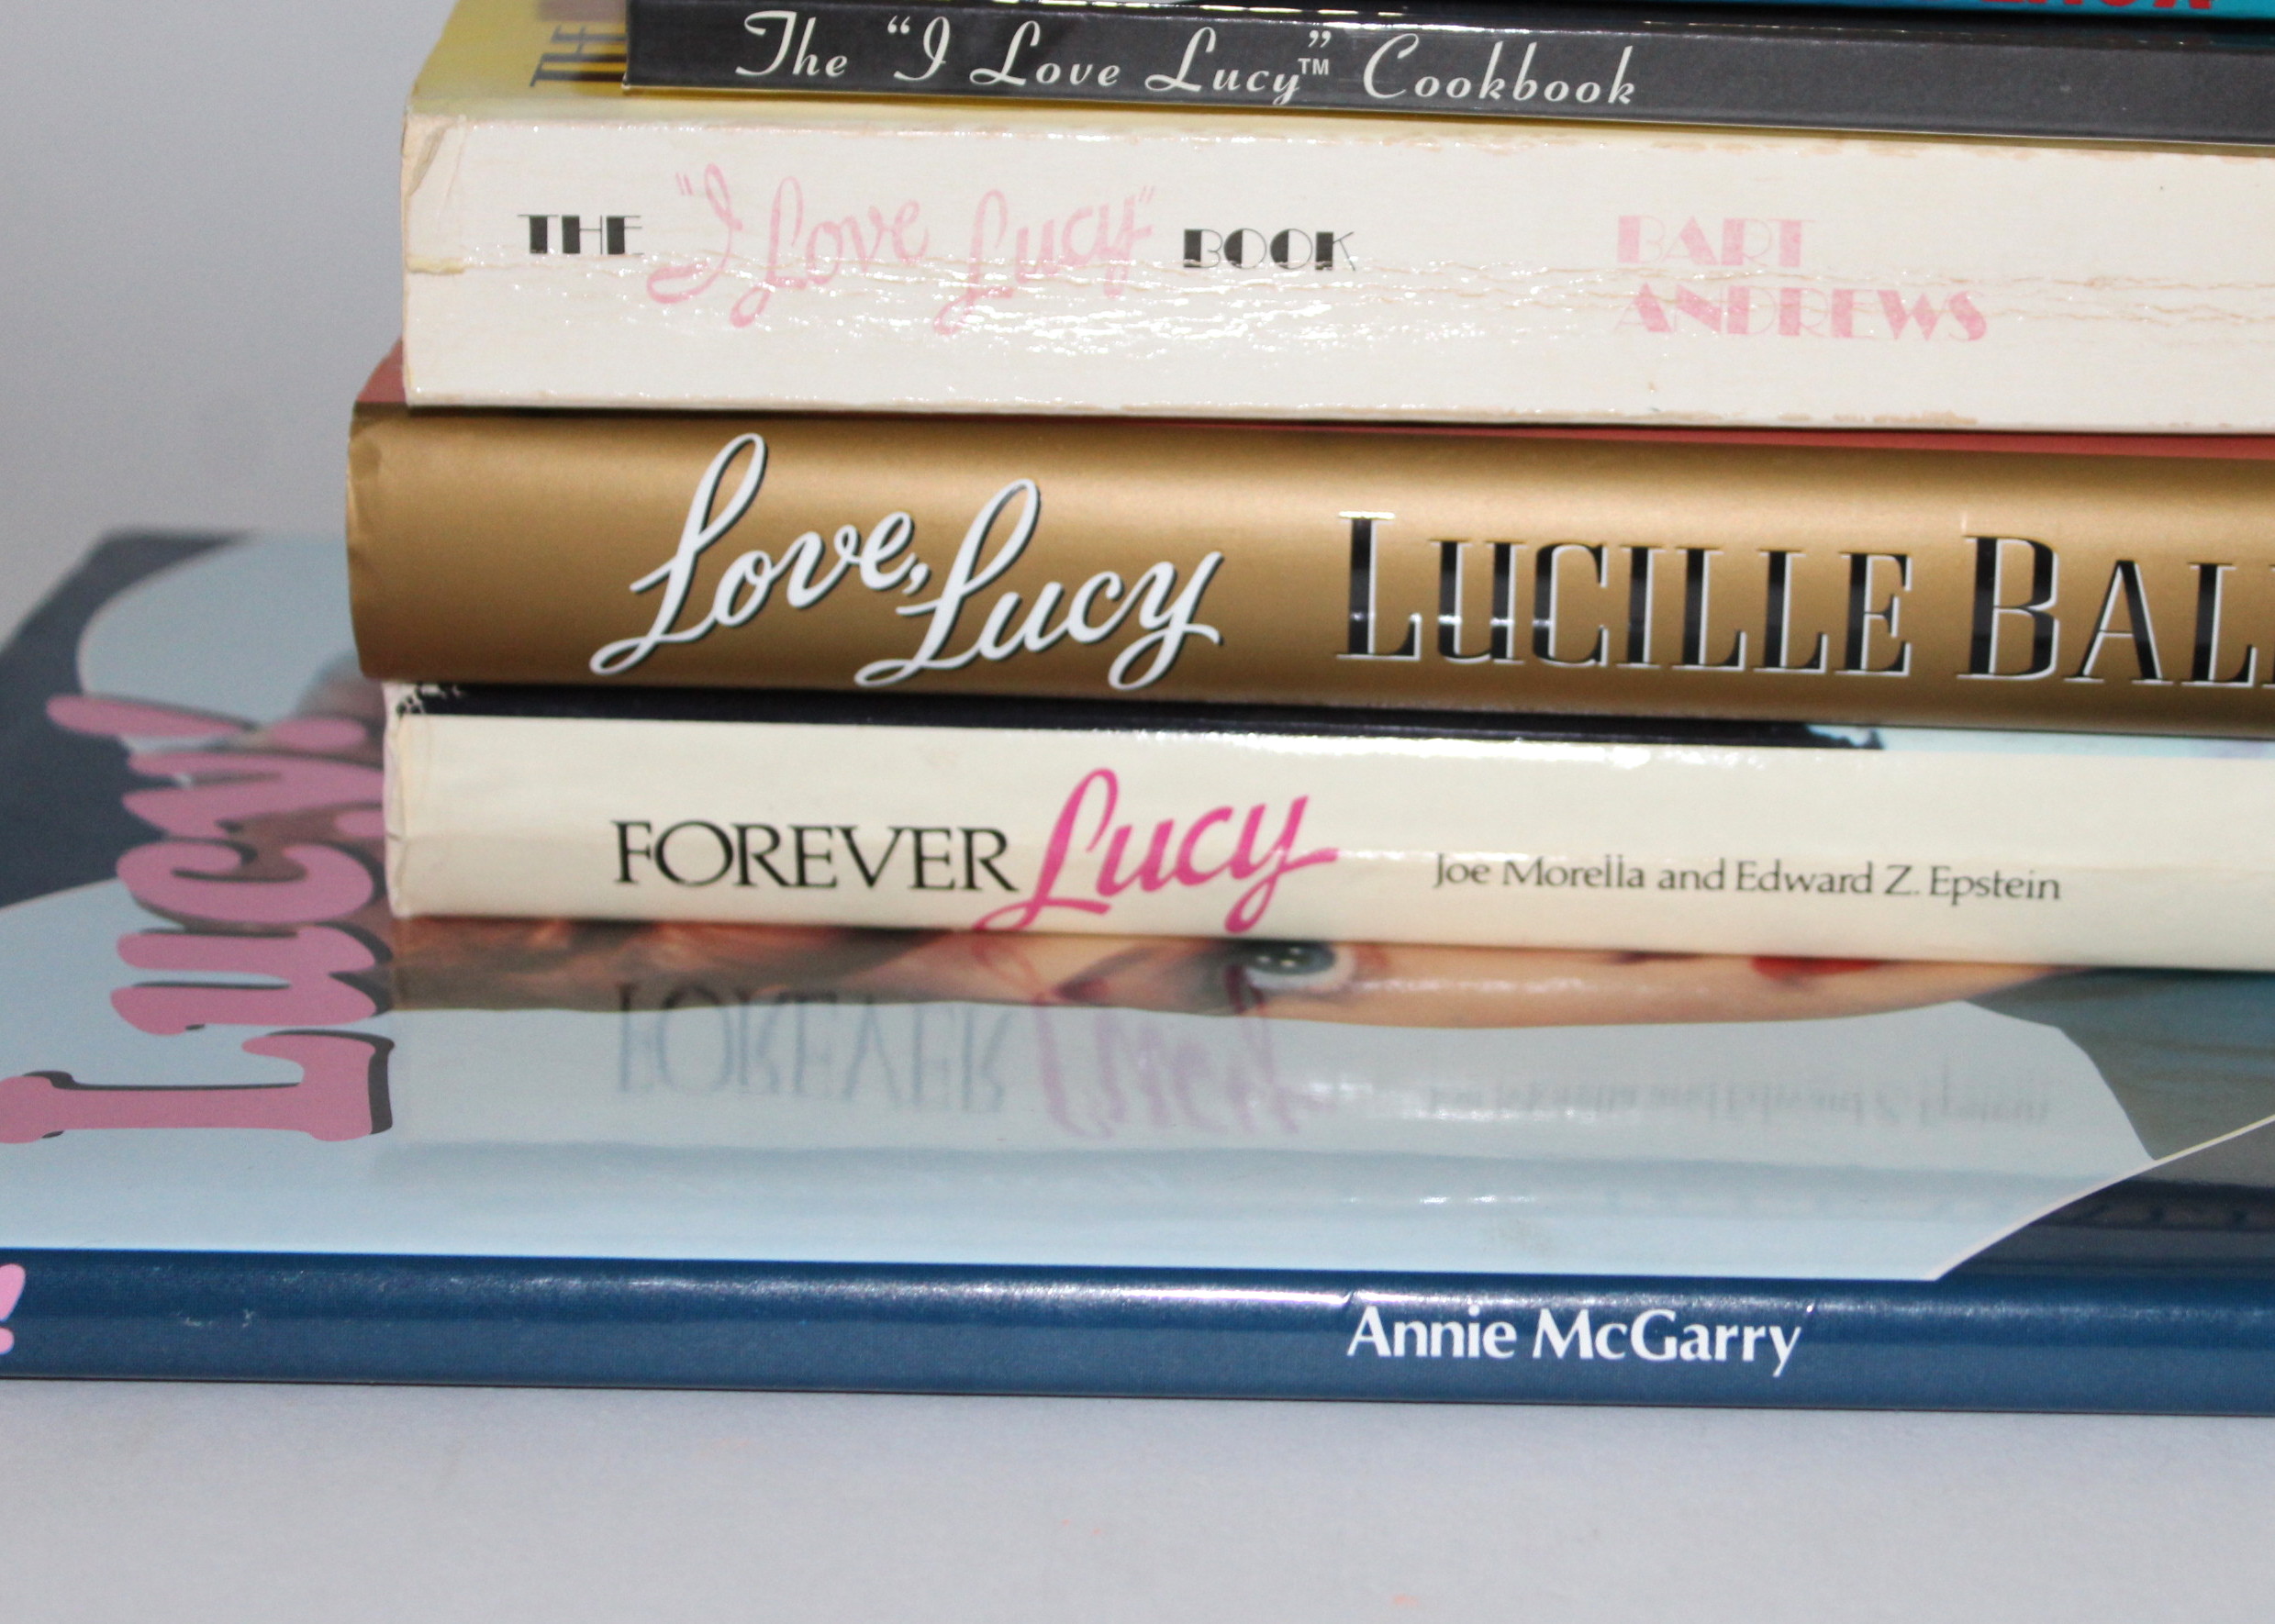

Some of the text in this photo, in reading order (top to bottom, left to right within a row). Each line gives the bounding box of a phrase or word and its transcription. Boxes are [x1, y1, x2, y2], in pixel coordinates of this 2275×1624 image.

[735, 10, 849, 78] The
[969, 20, 1121, 87] Love
[1363, 32, 1636, 104] Cookbook
[518, 214, 642, 256] THE
[730, 176, 931, 328] Love
[1183, 228, 1356, 271] BOOK
[1616, 215, 1816, 268] BART
[1613, 282, 1988, 342] ANDREWS
[589, 433, 1224, 690] Love, Lucy
[1336, 510, 2275, 690] LUCILLE BAL
[610, 768, 1340, 934] FOREVER Lucy
[1433, 853, 2063, 907] Joe Morella and Edward Z. Epstein
[1346, 1306, 1802, 1376] Annie McGarry
